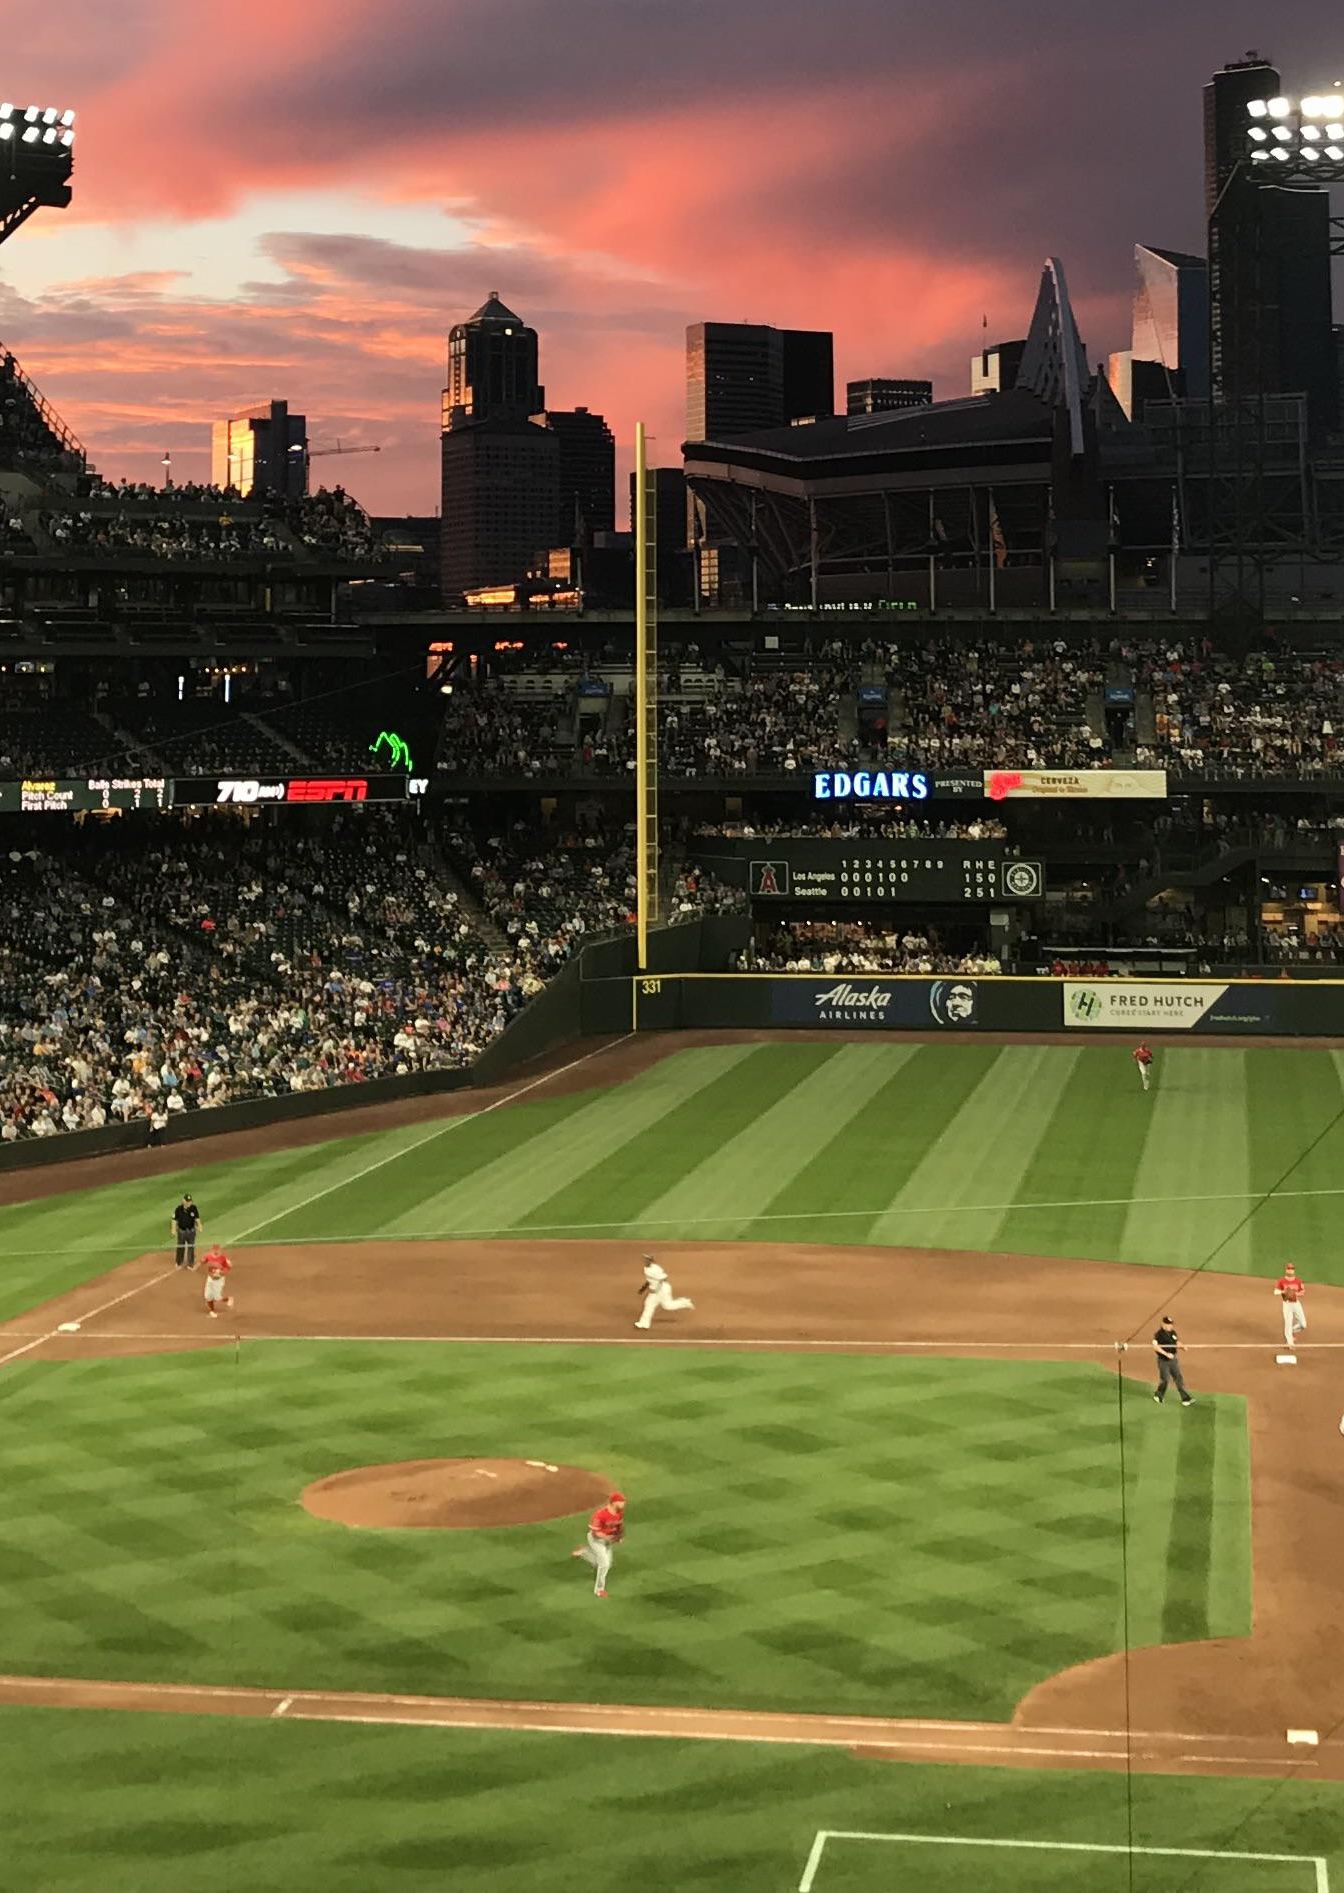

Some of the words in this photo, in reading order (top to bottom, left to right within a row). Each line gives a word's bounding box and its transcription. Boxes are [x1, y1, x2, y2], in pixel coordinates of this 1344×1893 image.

[21, 780, 56, 792] Alvarez
[111, 778, 142, 789] Strikes
[143, 778, 165, 789] Total
[935, 780, 983, 788] PRESENTED
[21, 790, 44, 800] Pitch
[47, 789, 74, 800] Count
[217, 781, 259, 802] 710
[288, 780, 368, 801] ESPN
[21, 801, 42, 811] First
[43, 800, 68, 810] Pitch
[842, 860, 847, 868] 1
[853, 860, 860, 868] 2
[865, 860, 872, 868] 3
[877, 860, 883, 868] 4
[889, 860, 896, 868] 5
[900, 860, 907, 868] 6
[912, 860, 919, 868] 7
[925, 860, 932, 868] 8
[937, 860, 944, 868] 9
[963, 861, 971, 869] R
[975, 861, 983, 869] H
[988, 861, 995, 869] E
[793, 872, 806, 881] Los
[807, 872, 836, 882] Angeles
[841, 872, 848, 882] 0
[853, 872, 860, 882] 0
[865, 872, 872, 882] 0
[878, 872, 883, 882] 1
[889, 872, 896, 882] 0
[901, 872, 908, 882] 0
[965, 873, 970, 883] 1
[976, 873, 983, 883] 5
[988, 873, 995, 883] 0
[795, 887, 827, 896] Seattle
[841, 887, 848, 896] 0
[853, 887, 860, 896] 0
[866, 887, 871, 896] 1
[877, 887, 884, 896] 0
[890, 887, 896, 896] 1
[964, 887, 971, 898] 2
[977, 887, 984, 898] 5
[989, 887, 995, 898] 1
[642, 980, 662, 994] 331
[814, 983, 892, 1008] Alaska
[1110, 995, 1149, 1007] FRED
[1153, 996, 1204, 1008] HUTCH
[819, 1010, 885, 1020] AIRLINES
